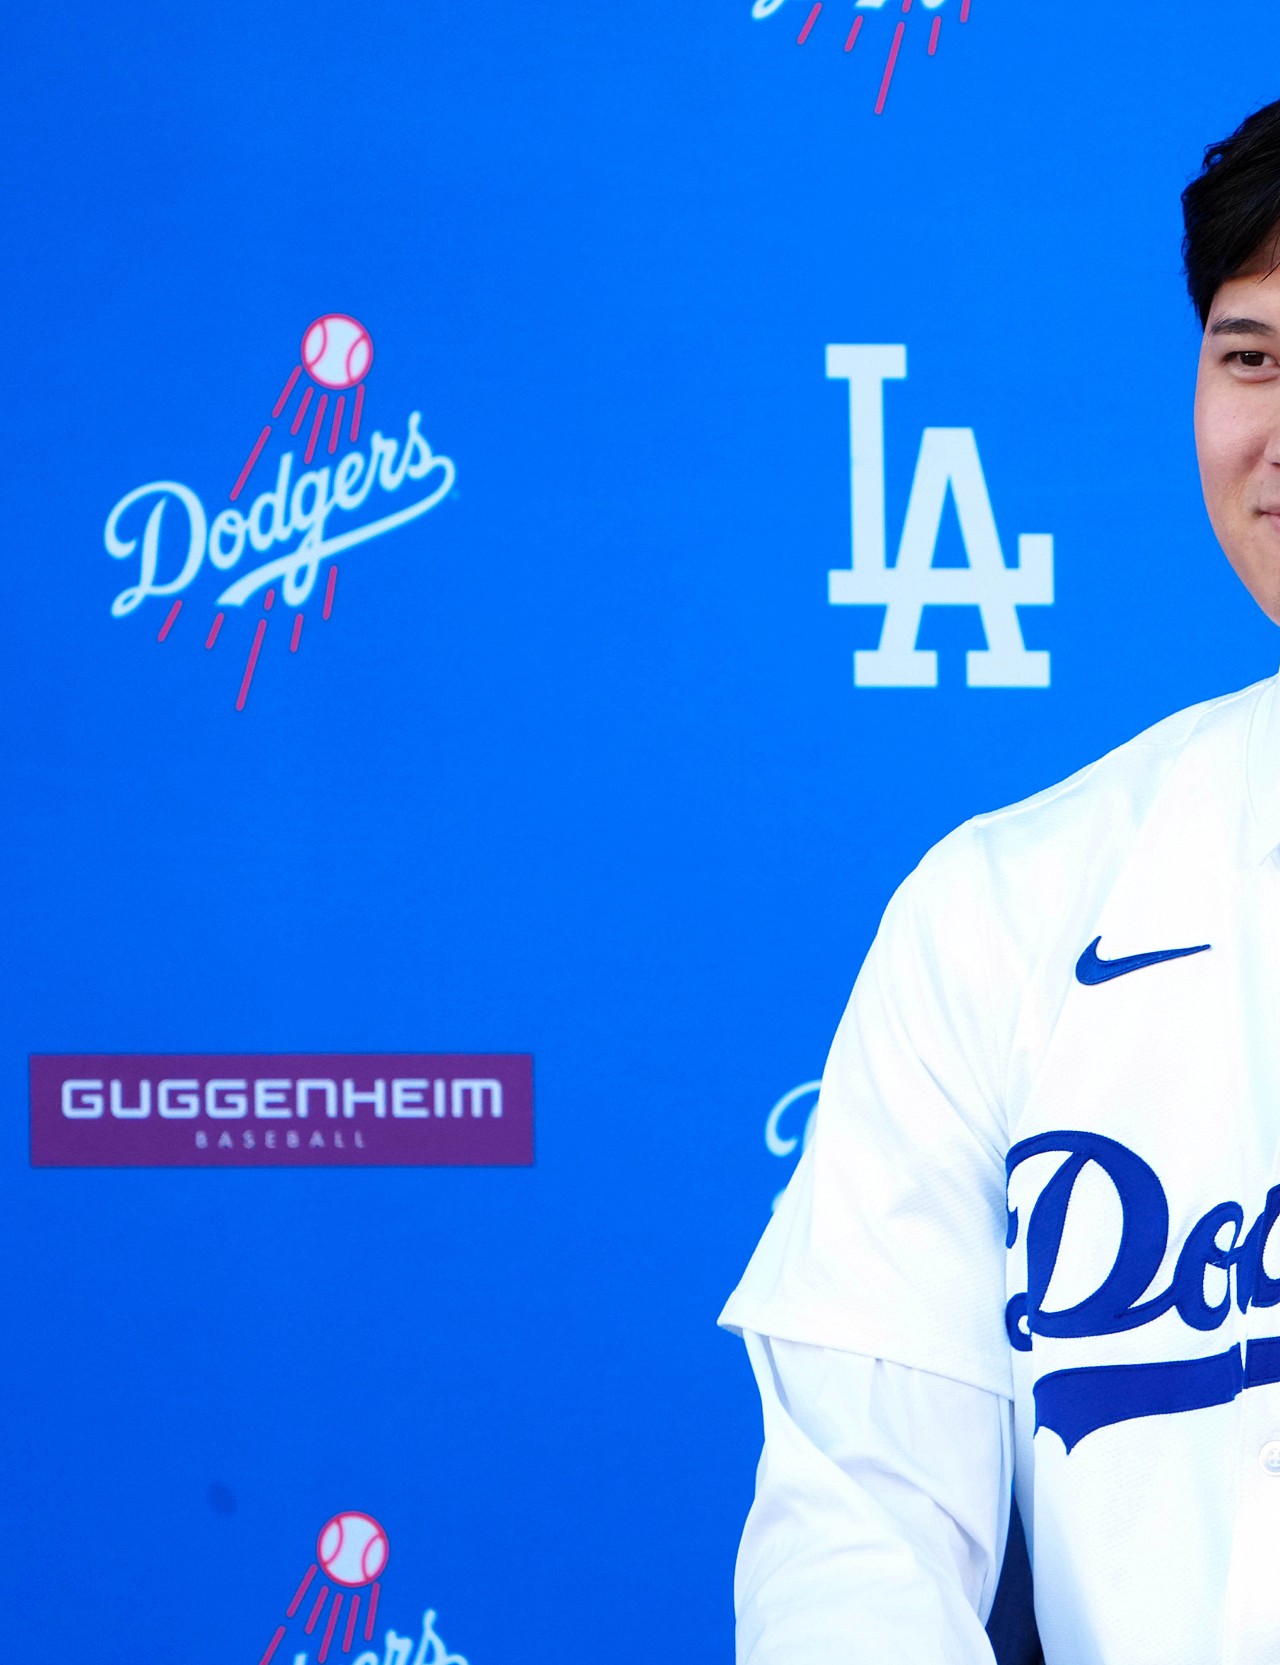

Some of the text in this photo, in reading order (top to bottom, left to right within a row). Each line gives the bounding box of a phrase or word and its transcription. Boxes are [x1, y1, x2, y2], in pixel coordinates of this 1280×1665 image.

[105, 412, 455, 616] Dodgers
[826, 344, 1054, 687] LA
[61, 1079, 503, 1119] GUGGENHEIM
[195, 1130, 365, 1149] BASEBALL
